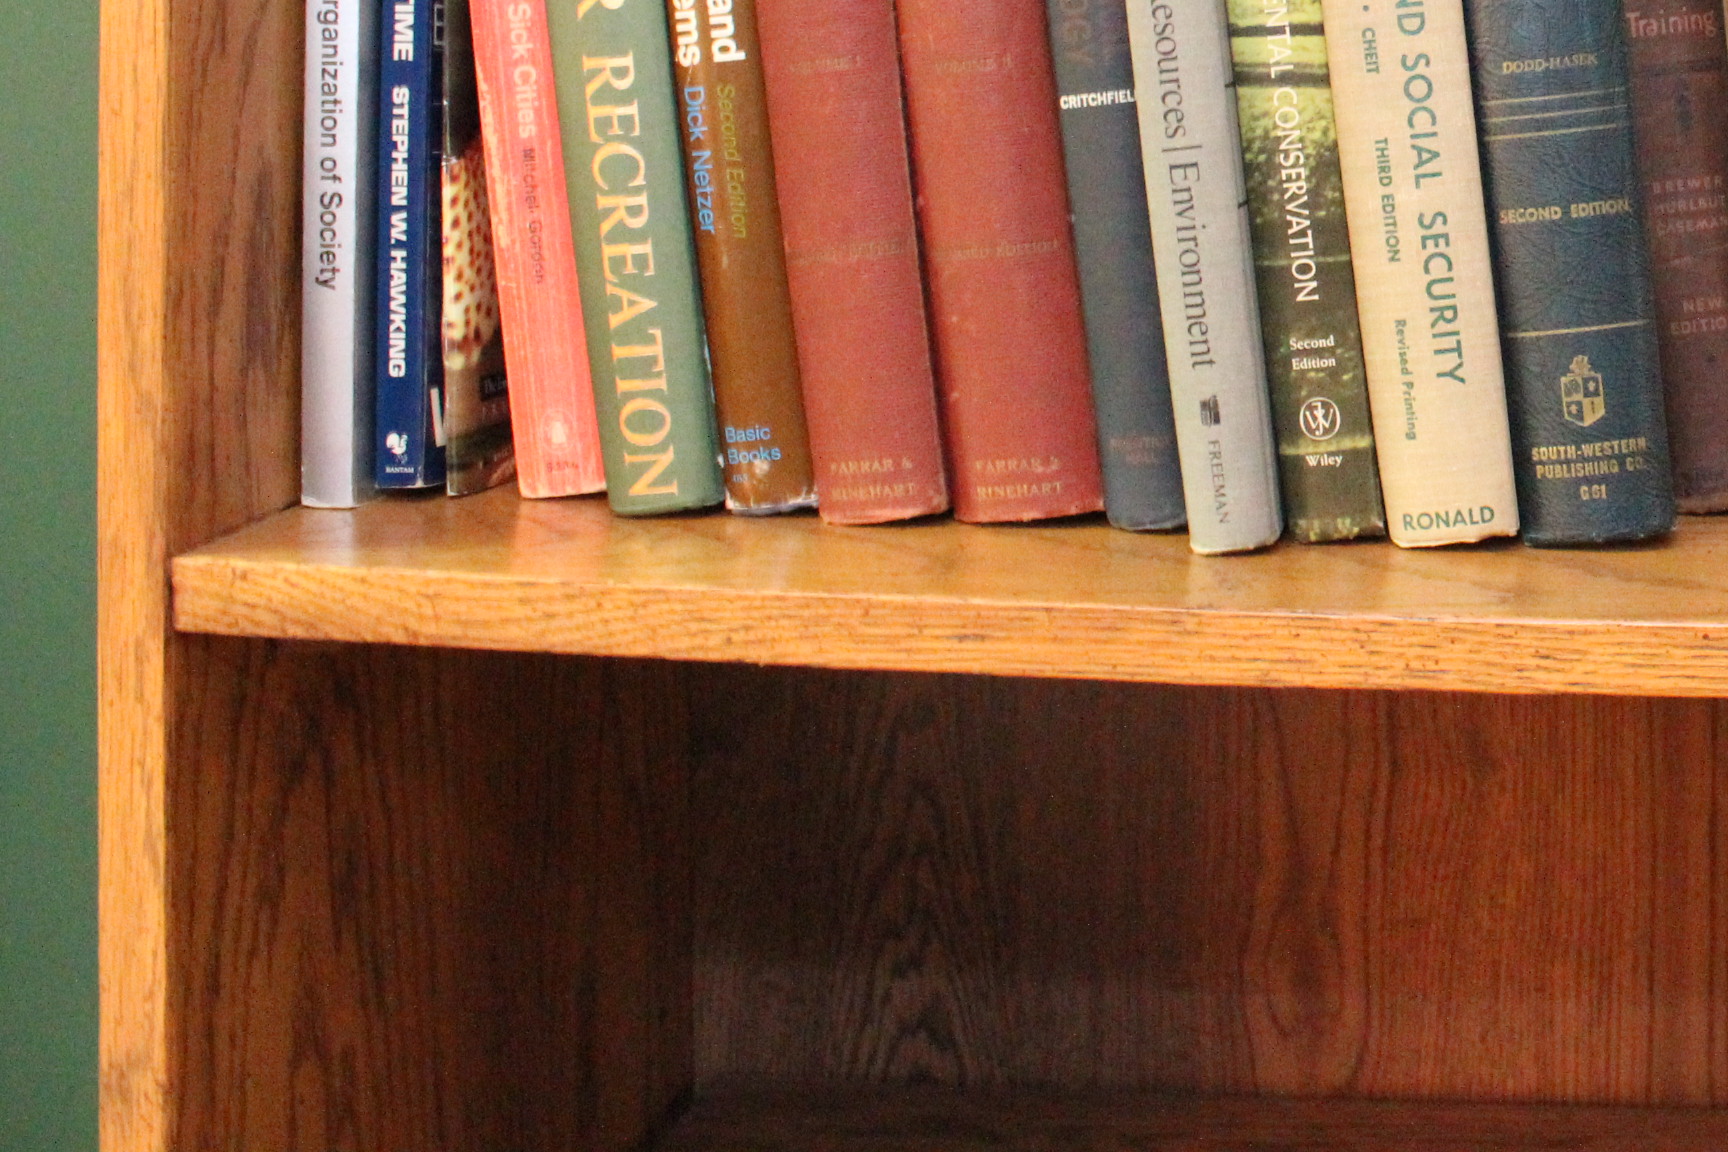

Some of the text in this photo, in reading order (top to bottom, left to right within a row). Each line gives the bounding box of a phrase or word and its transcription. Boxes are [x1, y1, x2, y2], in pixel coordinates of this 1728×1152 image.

[1626, 9, 1719, 39] Training
[507, 3, 537, 139] Sick Cities
[1361, 28, 1381, 75] CHEIT
[1060, 88, 1136, 110] CRITCHFIEL
[1400, 53, 1438, 189] SOCIAL
[319, 156, 343, 182] of
[683, 85, 717, 234] Dick Netzer
[725, 169, 747, 239] Edition
[1272, 86, 1320, 302] CONSERVATION
[1374, 137, 1402, 264] THIRD EDITION
[1500, 197, 1633, 226] SECOND EDITION
[315, 192, 343, 291] Society
[388, 85, 411, 378] STEPHEN W. HAWKING
[581, 50, 680, 498] RECREATION
[1168, 161, 1217, 370] Environment
[1416, 210, 1466, 385] SECURITY
[1682, 297, 1724, 313] NEW
[1289, 335, 1335, 351] Second
[1291, 357, 1337, 372] Edition
[1393, 319, 1418, 441] Revised Printing
[724, 425, 772, 443] Basic
[728, 445, 782, 464] Books
[1531, 437, 1647, 461] SOUTH-WESTERN
[1207, 440, 1232, 524] FREEMAN
[1305, 453, 1343, 468] Wiley
[1536, 457, 1619, 480] PUBLISHING
[1403, 506, 1495, 531] RONALD
